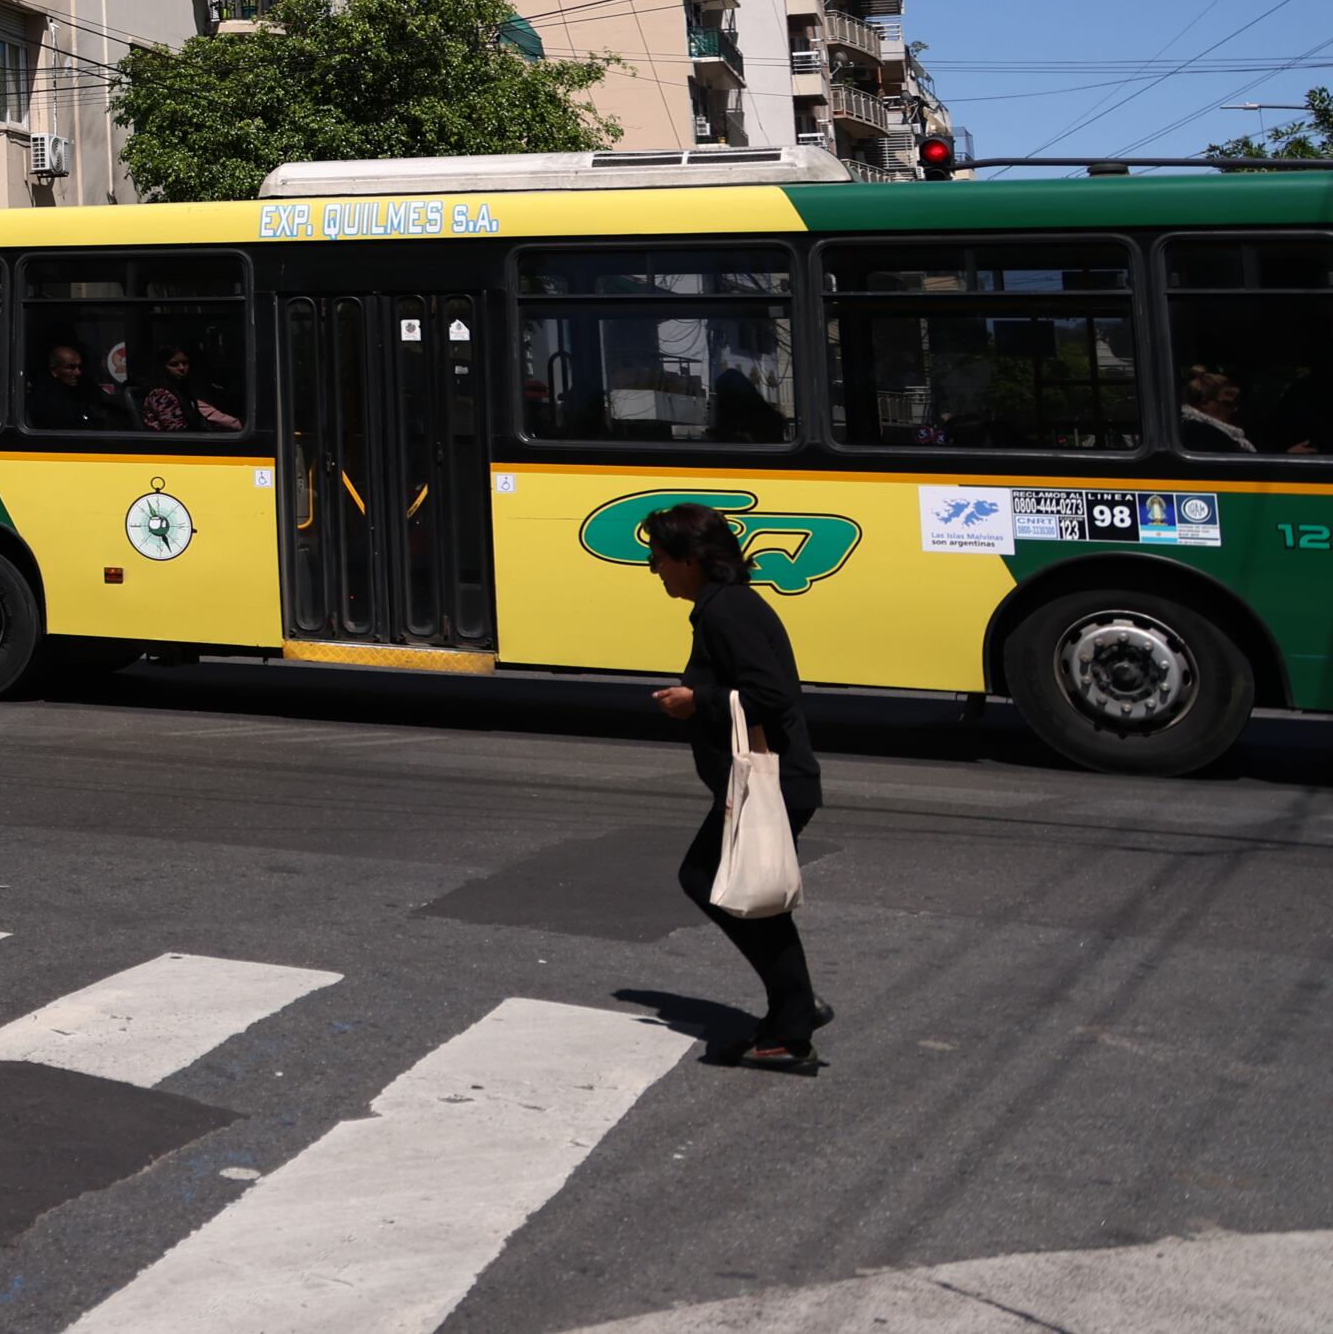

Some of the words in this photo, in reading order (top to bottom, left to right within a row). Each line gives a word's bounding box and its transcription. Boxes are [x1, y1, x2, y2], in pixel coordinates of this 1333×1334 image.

[260, 204, 313, 237] EXP.
[323, 200, 444, 240] QUILMES
[452, 203, 499, 233] S.A.
[1014, 491, 1066, 499] RECLAMOS
[1088, 493, 1133, 501] LINEA
[1014, 498, 1083, 515] 0800-444-0273
[1017, 517, 1053, 525] CNRT
[1093, 505, 1132, 528] 98
[1060, 520, 1079, 540] 123
[967, 533, 1004, 541] Malvinas
